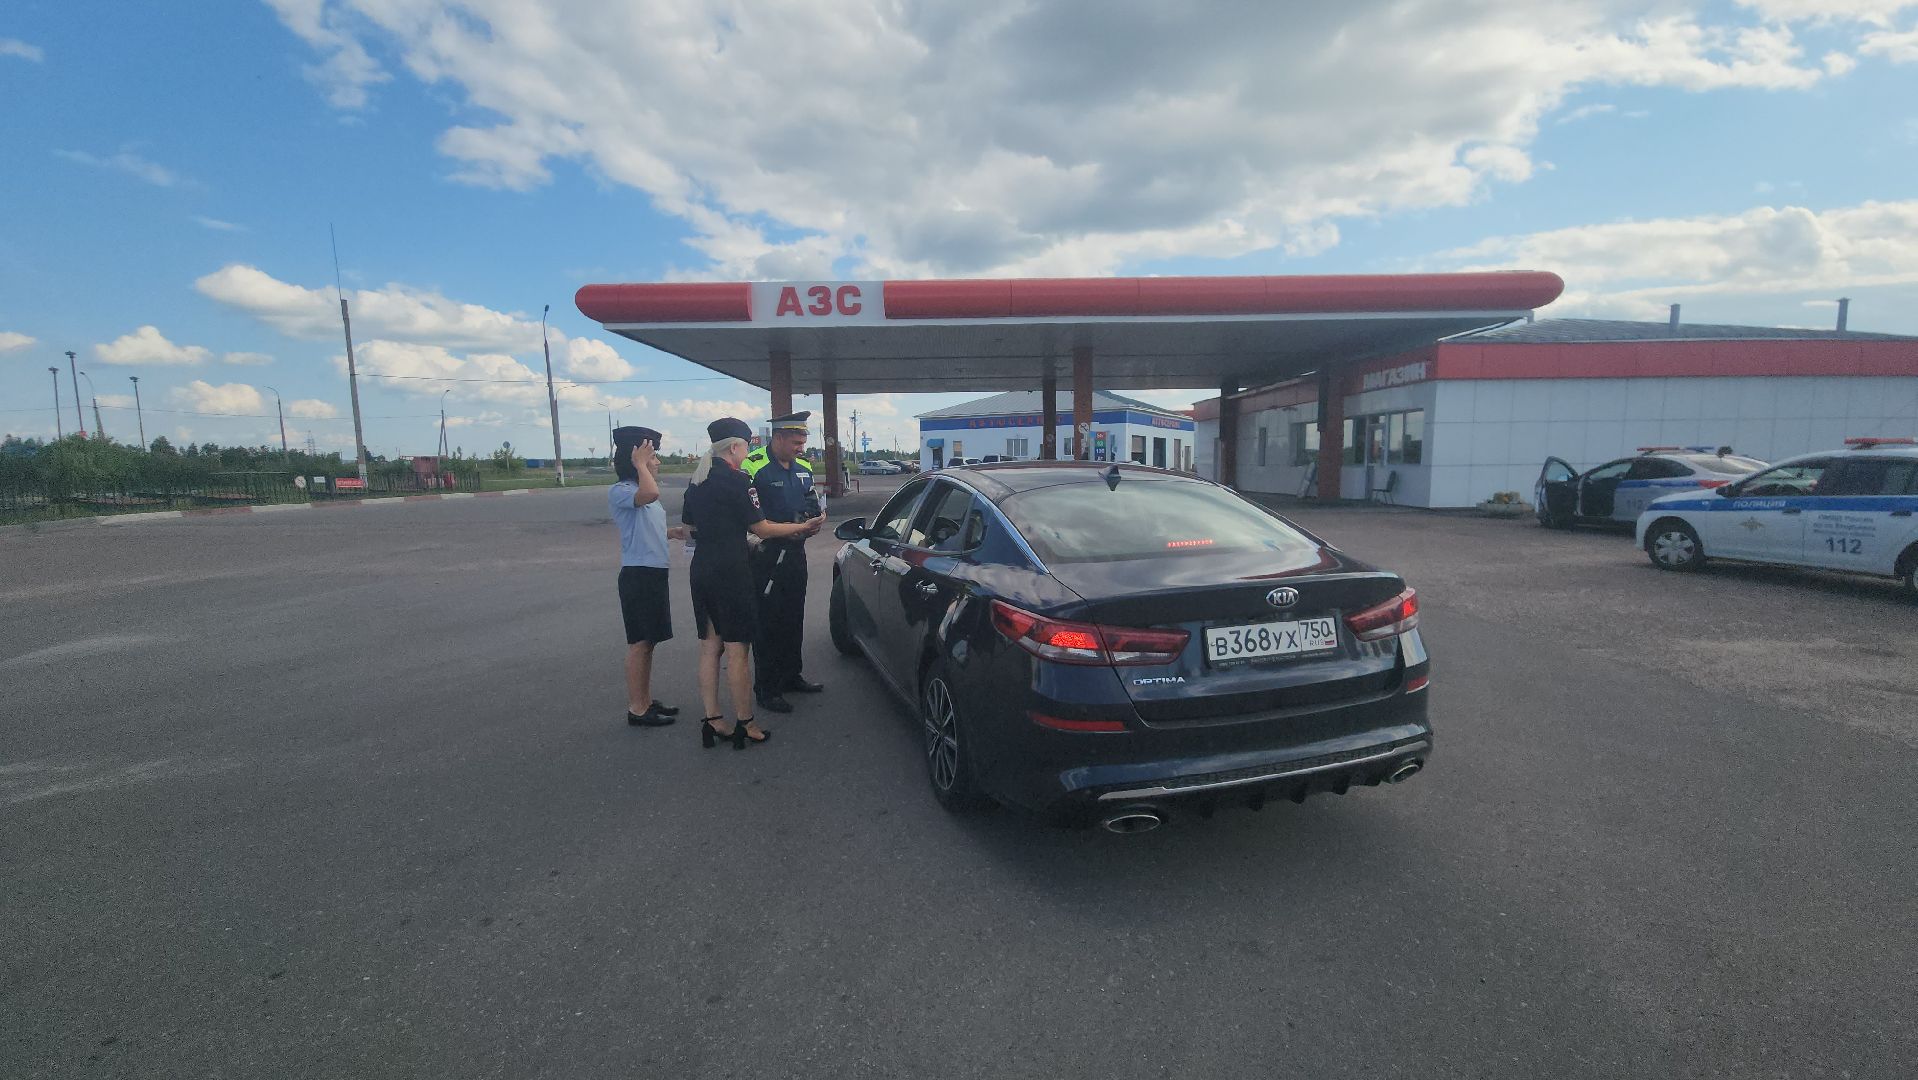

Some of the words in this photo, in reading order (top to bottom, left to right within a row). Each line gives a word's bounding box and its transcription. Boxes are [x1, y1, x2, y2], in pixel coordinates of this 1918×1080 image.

[776, 285, 862, 316] АЗС
[1363, 361, 1427, 389] МАГАЗИН
[1733, 500, 1786, 508] ПОЛИЦИЯ
[1825, 537, 1862, 554] 112
[1273, 592, 1295, 604] KIA
[1301, 620, 1333, 640] 750
[1309, 639, 1324, 647] RUS
[1133, 676, 1186, 685] OPTIMA
